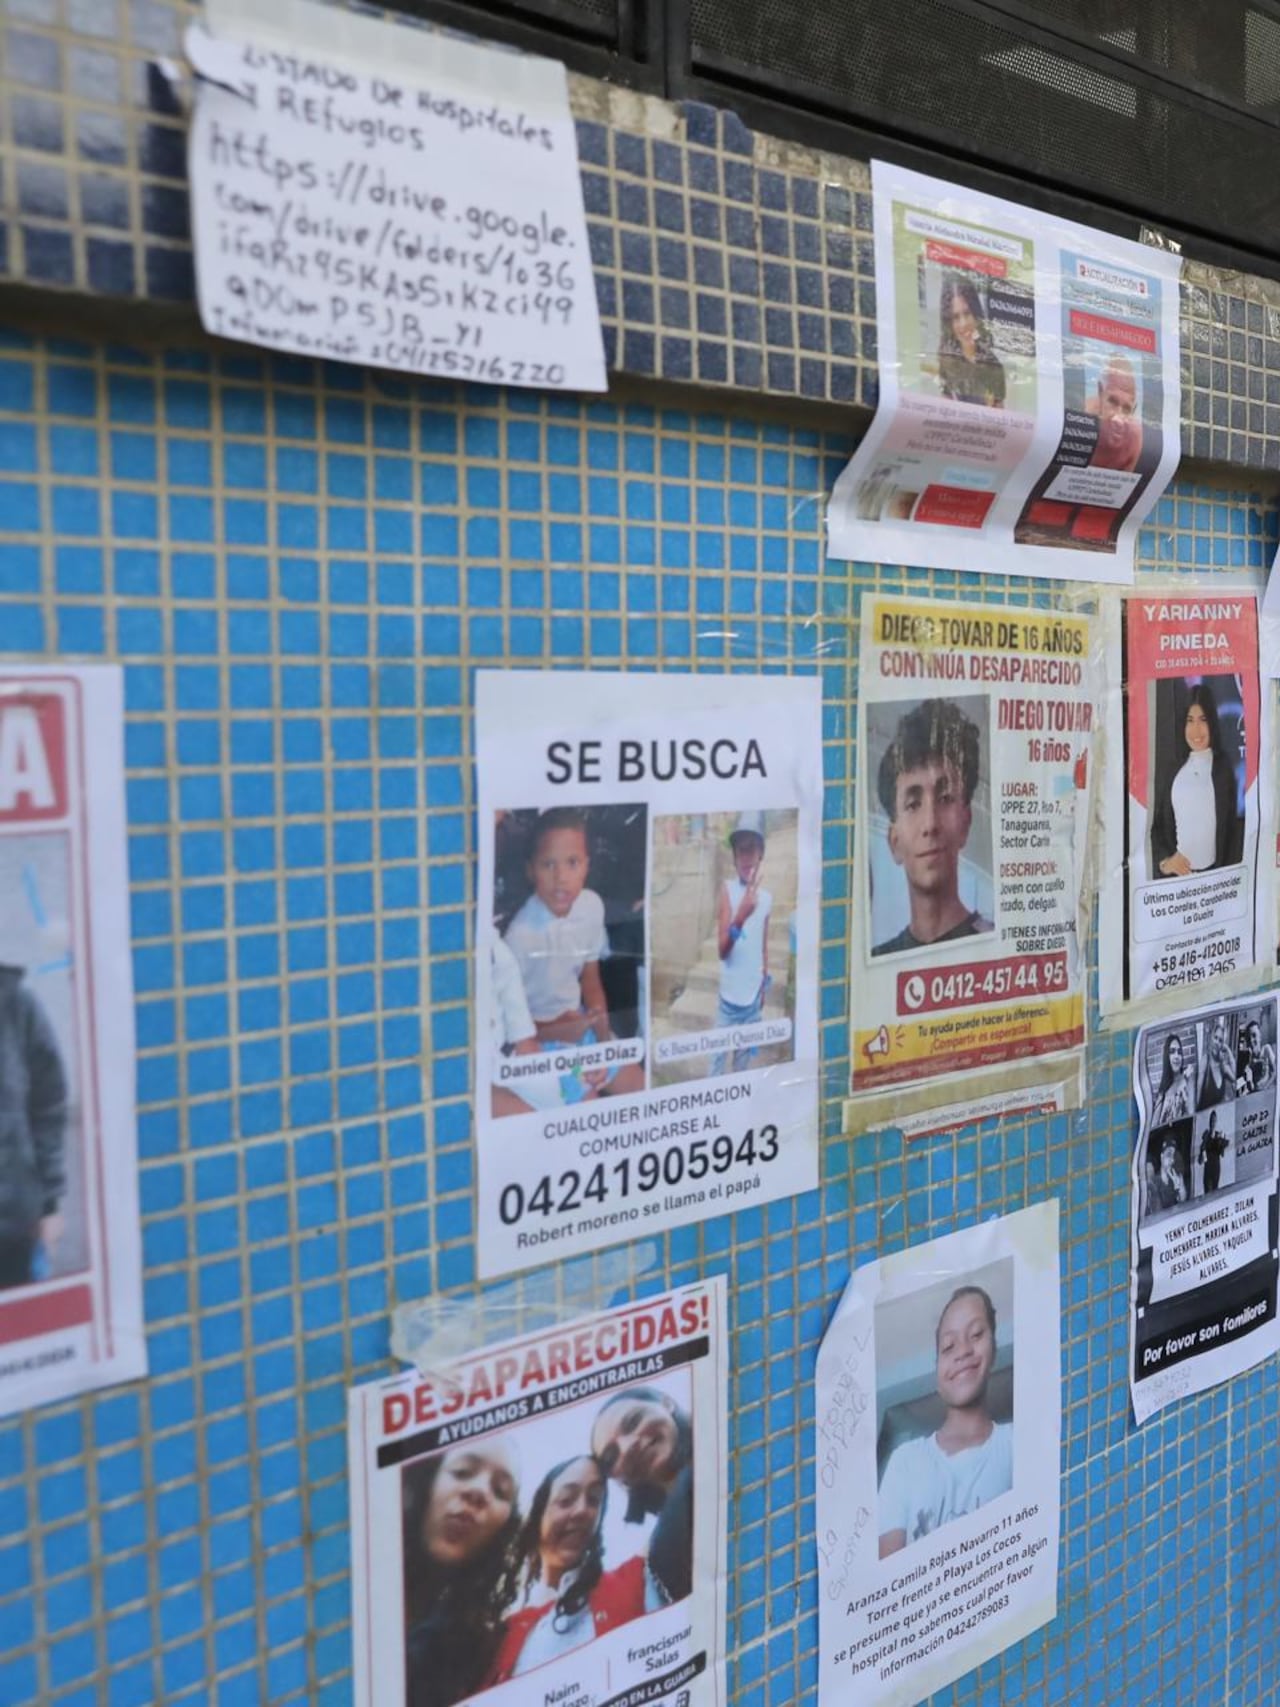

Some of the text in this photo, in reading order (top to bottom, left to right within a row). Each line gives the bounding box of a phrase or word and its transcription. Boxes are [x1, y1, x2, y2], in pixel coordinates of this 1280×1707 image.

[1144, 604, 1242, 621] YARIANNY
[940, 619, 992, 647] TOVAR
[997, 622, 1018, 648] DE
[1022, 625, 1038, 650] 16
[1042, 621, 1082, 654] AÑOS
[1160, 633, 1229, 651] PINEDA
[970, 656, 1081, 685] DESAPARECIDO
[998, 699, 1092, 732] DIEGO TOVAR
[545, 739, 768, 785] SE BUSCA
[1028, 739, 1071, 762] 16 años
[1002, 783, 1038, 797] LUGAR:
[1001, 801, 1025, 814] OPPE
[1000, 836, 1028, 848] Sector
[1000, 884, 1043, 895] Joven con
[1144, 884, 1212, 905] Última ubicación
[1151, 909, 1166, 918] Los
[1168, 901, 1198, 914] Corales,
[1184, 916, 1192, 925] La
[1008, 926, 1037, 939] TIENES
[1016, 939, 1045, 951] SOBRE
[1165, 939, 1194, 951] Contacto
[1153, 956, 1177, 973] +58
[931, 961, 1064, 1003] 0412-457 44 95
[918, 1014, 1004, 1037] Tu ayuda puede hacer
[930, 1035, 976, 1054] ¡Compartir
[978, 1030, 988, 1041] es
[498, 1045, 638, 1081] Daniel Quiroz Díaz
[543, 1083, 751, 1140] CUALQUIER INFORMACION
[578, 1113, 722, 1158] COMUNICARSE AL
[498, 1124, 780, 1226] 04241905943
[517, 1173, 761, 1251] Robert moreno se llama el papá
[1165, 1227, 1185, 1243] YENNY
[1188, 1206, 1229, 1233] COLMENAREZ
[1160, 1210, 1259, 1263] COLMENAREZ, MARINA ALVARES,
[1193, 1245, 1222, 1270] ALVARES,
[1143, 1300, 1267, 1366] Por favor son familiares
[382, 1294, 710, 1436] DESAPARECIDAS!
[438, 1354, 664, 1445] AYÚDANOS A ENCONTRARLAS
[846, 1504, 1039, 1616] Aranza Camila Rojas Navarro 11 años
[867, 1531, 1022, 1624] Torre frente a Playa Los Cocos
[834, 1536, 1049, 1664] se presume que ya se encuentra en algún
[852, 1563, 1034, 1675] hospital no sabemos cual por favor
[880, 1594, 1010, 1680] información 04242789083
[645, 1649, 679, 1672] Salas
[544, 1682, 580, 1705] Naim
[630, 1691, 645, 1704] EN
[647, 1683, 662, 1698] LA
